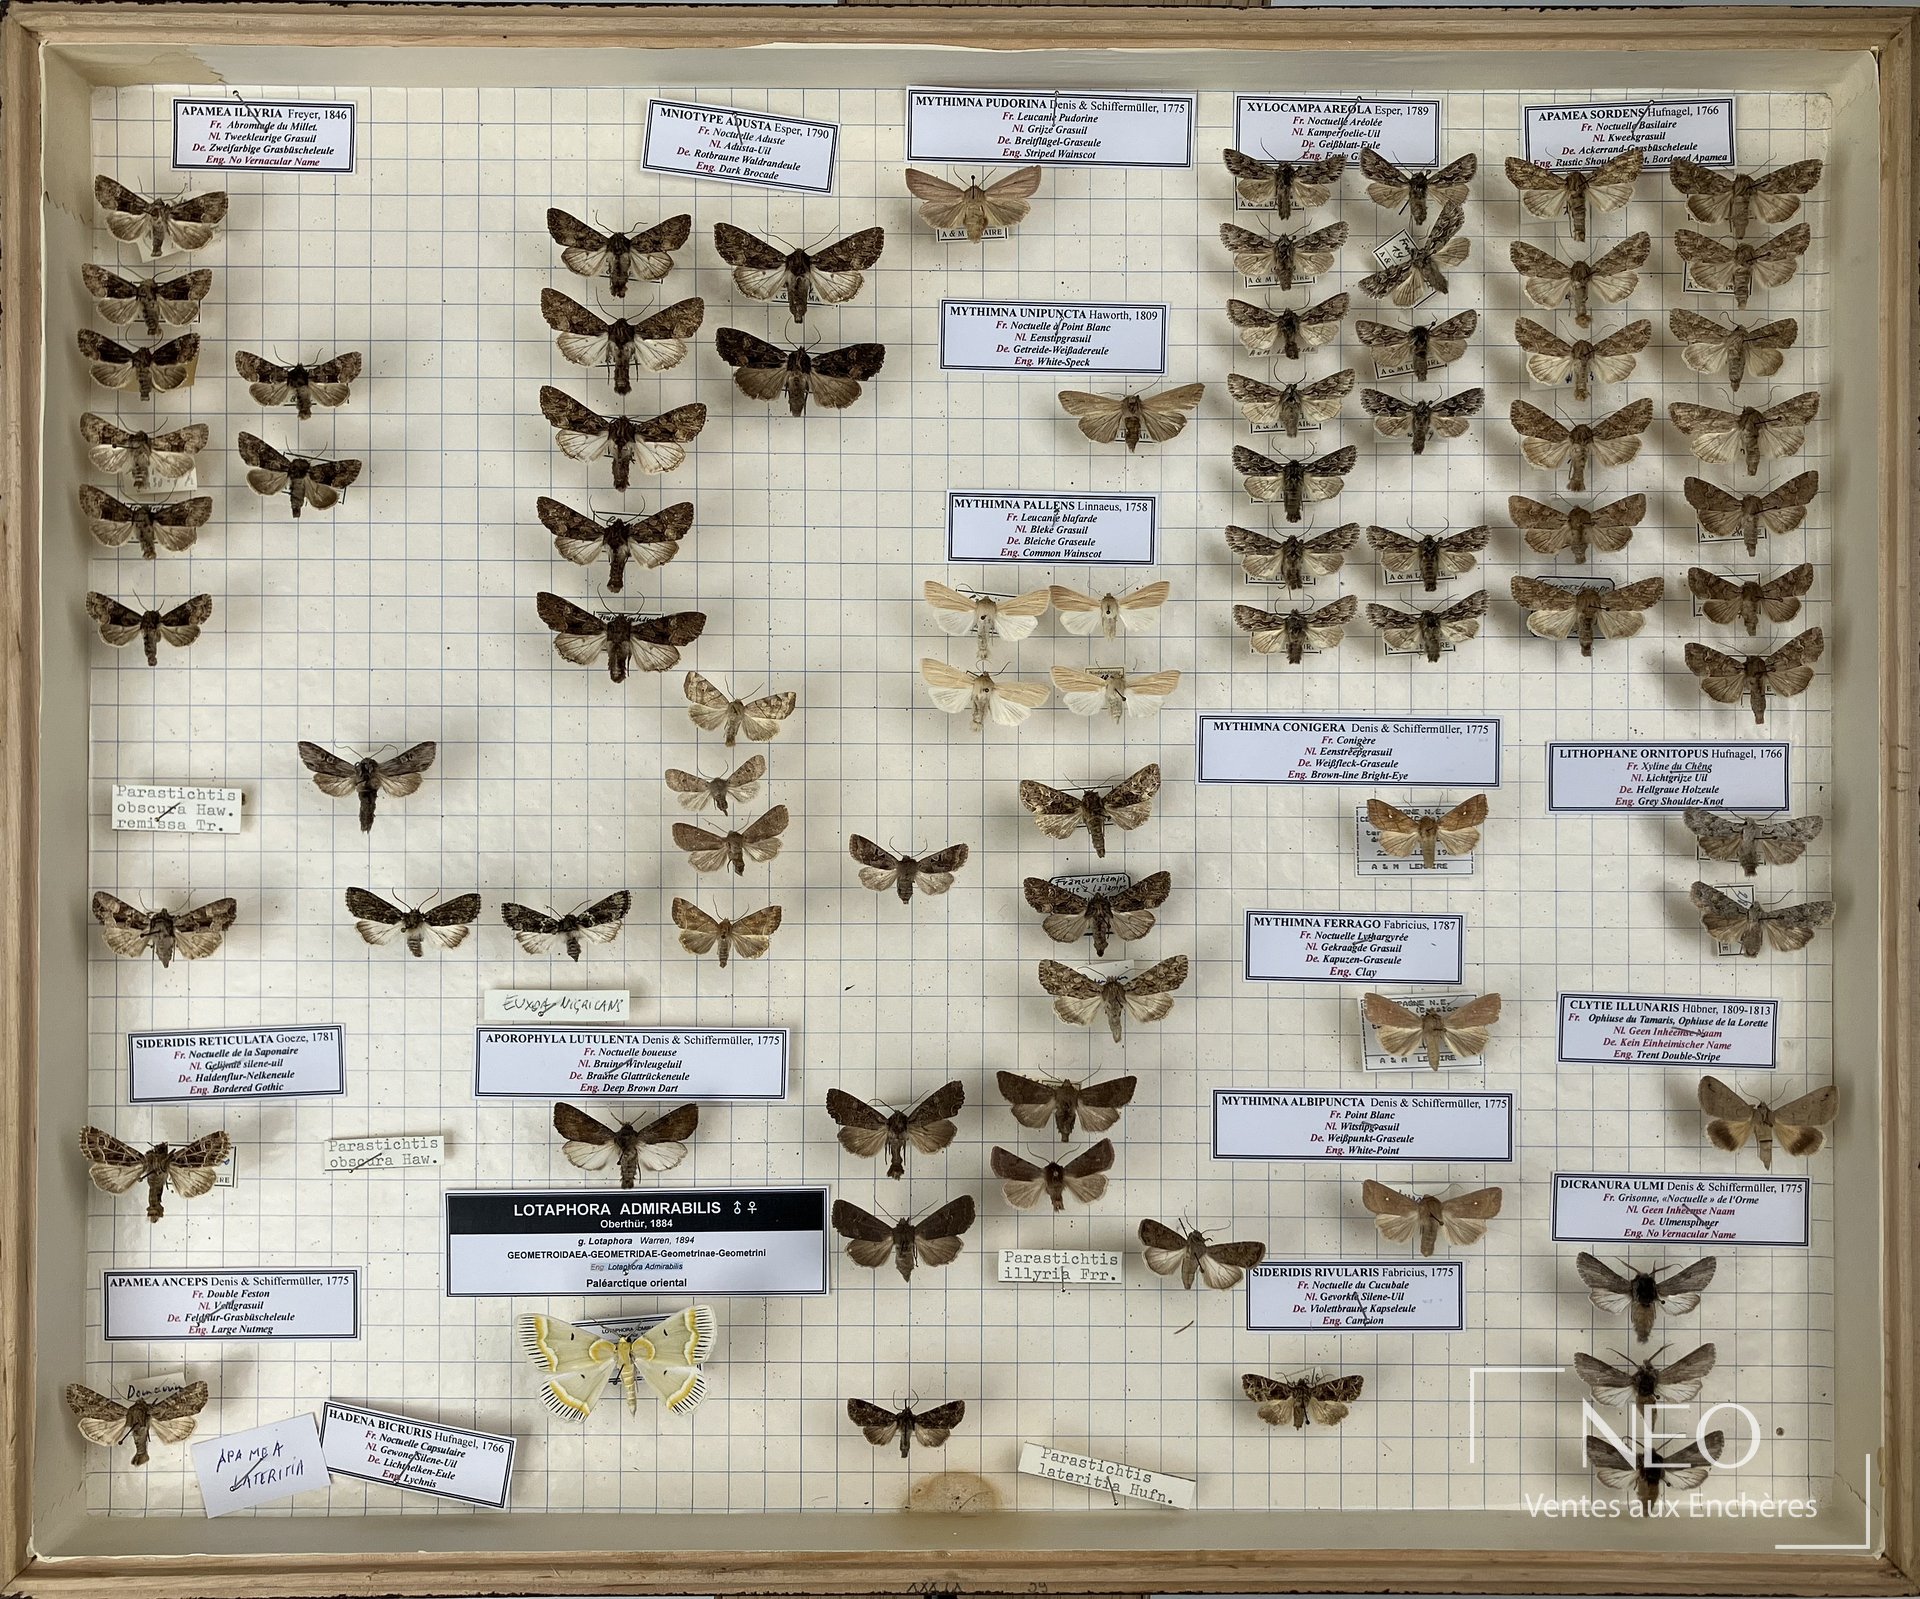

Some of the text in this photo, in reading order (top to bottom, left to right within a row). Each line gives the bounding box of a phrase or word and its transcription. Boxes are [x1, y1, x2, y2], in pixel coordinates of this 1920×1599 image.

[916, 97, 1184, 114] MYTHIMNA PUDORINA Denis & Schiffermüller, 1775
[1248, 103, 1429, 116] XYLOCAMPA AREOLA Esper, 1789
[182, 106, 346, 121] APAMEA ILLYRIA Freyer, 1846
[1539, 106, 1719, 121] APAMEA SORDENS Hufnagel, 1766
[660, 107, 829, 139] MNIOTYPE ADUSTA Esper, 1790
[1292, 128, 1380, 138] Nl. Kamperfoelie-Uil
[1593, 132, 1666, 142] Nl. Kweekgrasuil
[206, 155, 320, 166] Eng. No Vernacular Name
[696, 162, 779, 180] Eng. Dark Brocade
[950, 306, 1157, 320] MYTHIMNA UNIPUNCTA Haworth, 1809
[1015, 357, 1090, 367] Eng. White-Speck
[955, 499, 1148, 512] MYTHIMNA PALLENS Linnaeus, 1758
[1214, 722, 1489, 735] MYTHIMNA CONIGERA Denis & Schiffermüller, 1775
[1560, 750, 1782, 760] LITHOPHANE ORNITOPUS Hufnagel, 1766
[117, 785, 236, 801] Parastichtis
[117, 802, 233, 816] obscura Haw.
[117, 817, 223, 831] remissa Tr.
[1254, 917, 1455, 930] MYTHIMNA FERRAGO Fabricius, 1787
[1330, 967, 1377, 978] Eng. Clay
[1570, 1000, 1771, 1015] CLYTIE ILLUNARIS Hübner, 1809-1813
[136, 1032, 334, 1048] SIDERIDIS RETICULATA Goeze, 1781
[486, 1035, 780, 1047] APOROPHYLA LUTULENTA Denis & Schiffermüller, 1775
[580, 1084, 678, 1094] Eng. Deep Brown Dart
[1222, 1096, 1507, 1109] MYTHIMNA ALBIPUNCTA Denis & Schiffermüller, 1775
[329, 1137, 438, 1152] Parastichtis
[1325, 1146, 1399, 1155] Eng. White-Point
[403, 1154, 437, 1165] Haw.
[1561, 1180, 1802, 1193] DICRANURA ULMI Denis & Schiffermüller, 1775
[514, 1202, 721, 1217] LOTAPHORA ADMIRABILIS
[600, 1219, 673, 1230] Oberthür, 1884
[589, 1236, 633, 1246] Lotaphora
[640, 1236, 672, 1245] Warren,
[675, 1235, 695, 1244] 1894
[1004, 1251, 1118, 1265] Parastichtis
[645, 1262, 683, 1271] Admirabilis
[1253, 1268, 1453, 1278] SIDERIDIS RIVULARIS Fabricius, 1775
[1004, 1267, 1115, 1282] illyria Frr.
[110, 1276, 349, 1287] APAMEA ANCEPS Denis & Schiffermüller, 1775
[586, 1277, 687, 1289] Paléarctique oriental
[329, 1409, 504, 1453] HADENA BICRURIS Hufnagel, 1766
[1041, 1446, 1151, 1483] Parastichtis
[1039, 1463, 1172, 1504] lateritia Hufn.
